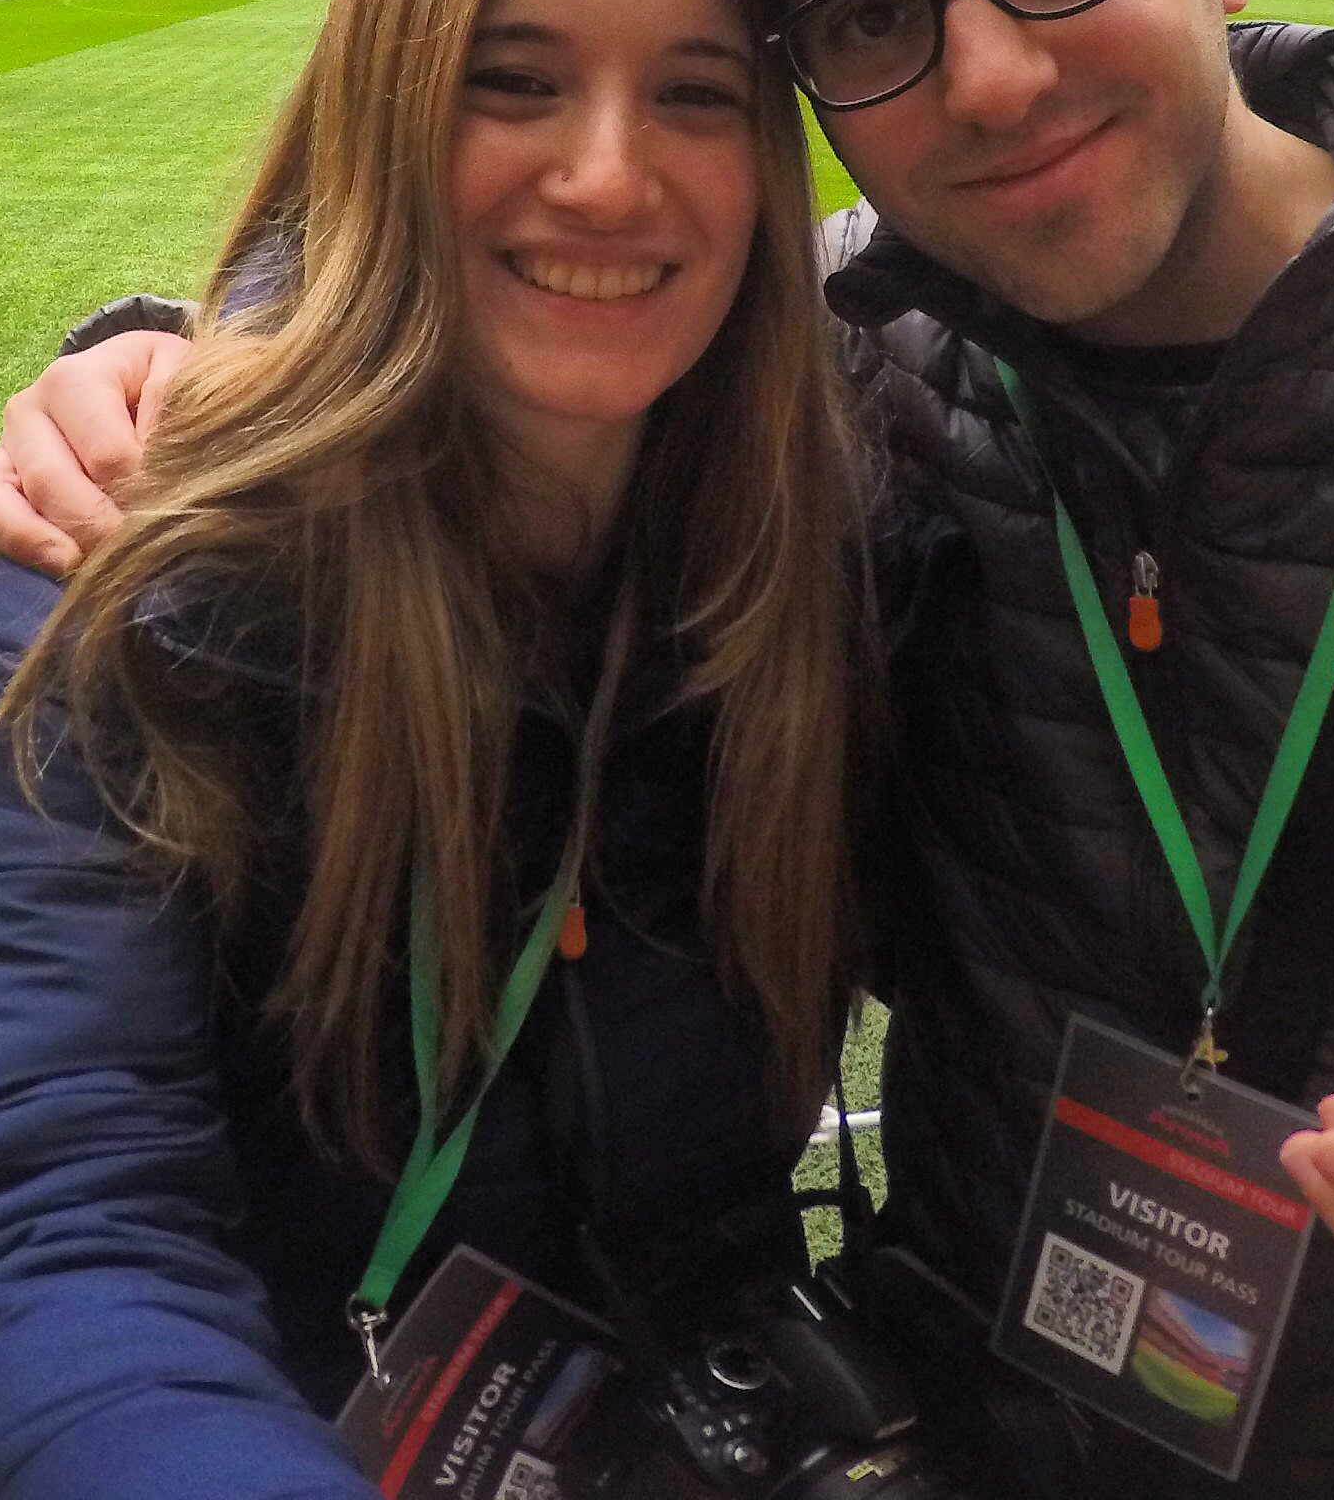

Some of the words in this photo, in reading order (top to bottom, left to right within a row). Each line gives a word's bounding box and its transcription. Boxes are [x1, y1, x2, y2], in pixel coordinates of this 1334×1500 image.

[1064, 1197, 1151, 1252] STADIUM
[1154, 1240, 1208, 1279] TOUR
[1211, 1268, 1259, 1306] PASS
[1108, 1181, 1230, 1260] VISITOR
[434, 1361, 516, 1486] VISITOR
